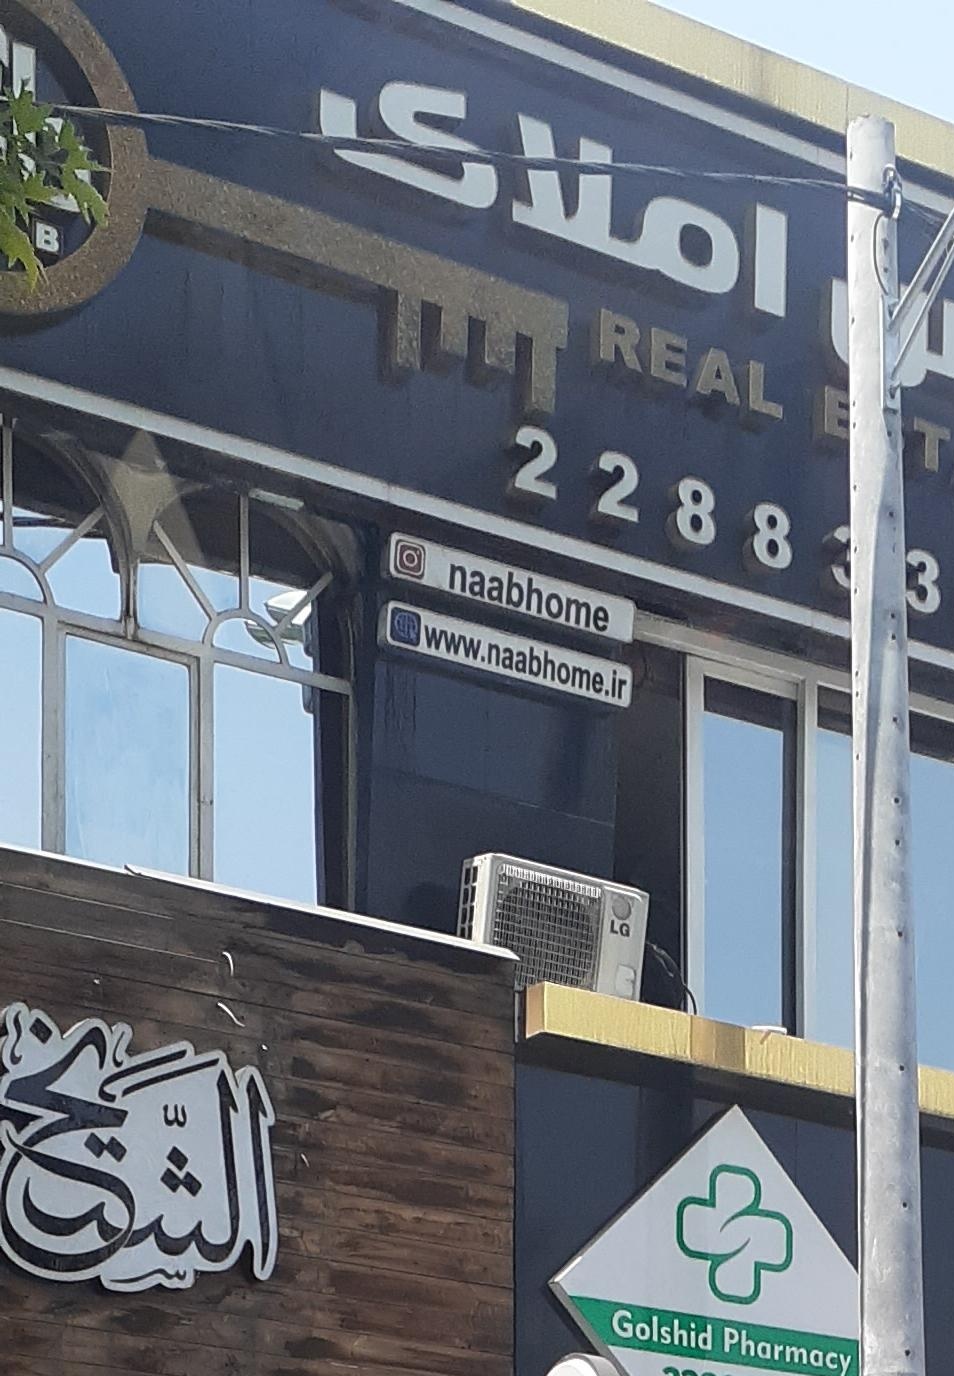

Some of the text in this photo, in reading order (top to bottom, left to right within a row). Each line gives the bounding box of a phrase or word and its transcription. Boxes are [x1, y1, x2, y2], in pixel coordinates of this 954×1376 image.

[319, 80, 788, 318] املاک
[598, 307, 784, 421] REAL
[449, 563, 610, 632] naabhome
[424, 624, 627, 700] www.naabhome.ir
[610, 919, 631, 937] LG
[611, 1308, 713, 1351] Golshid
